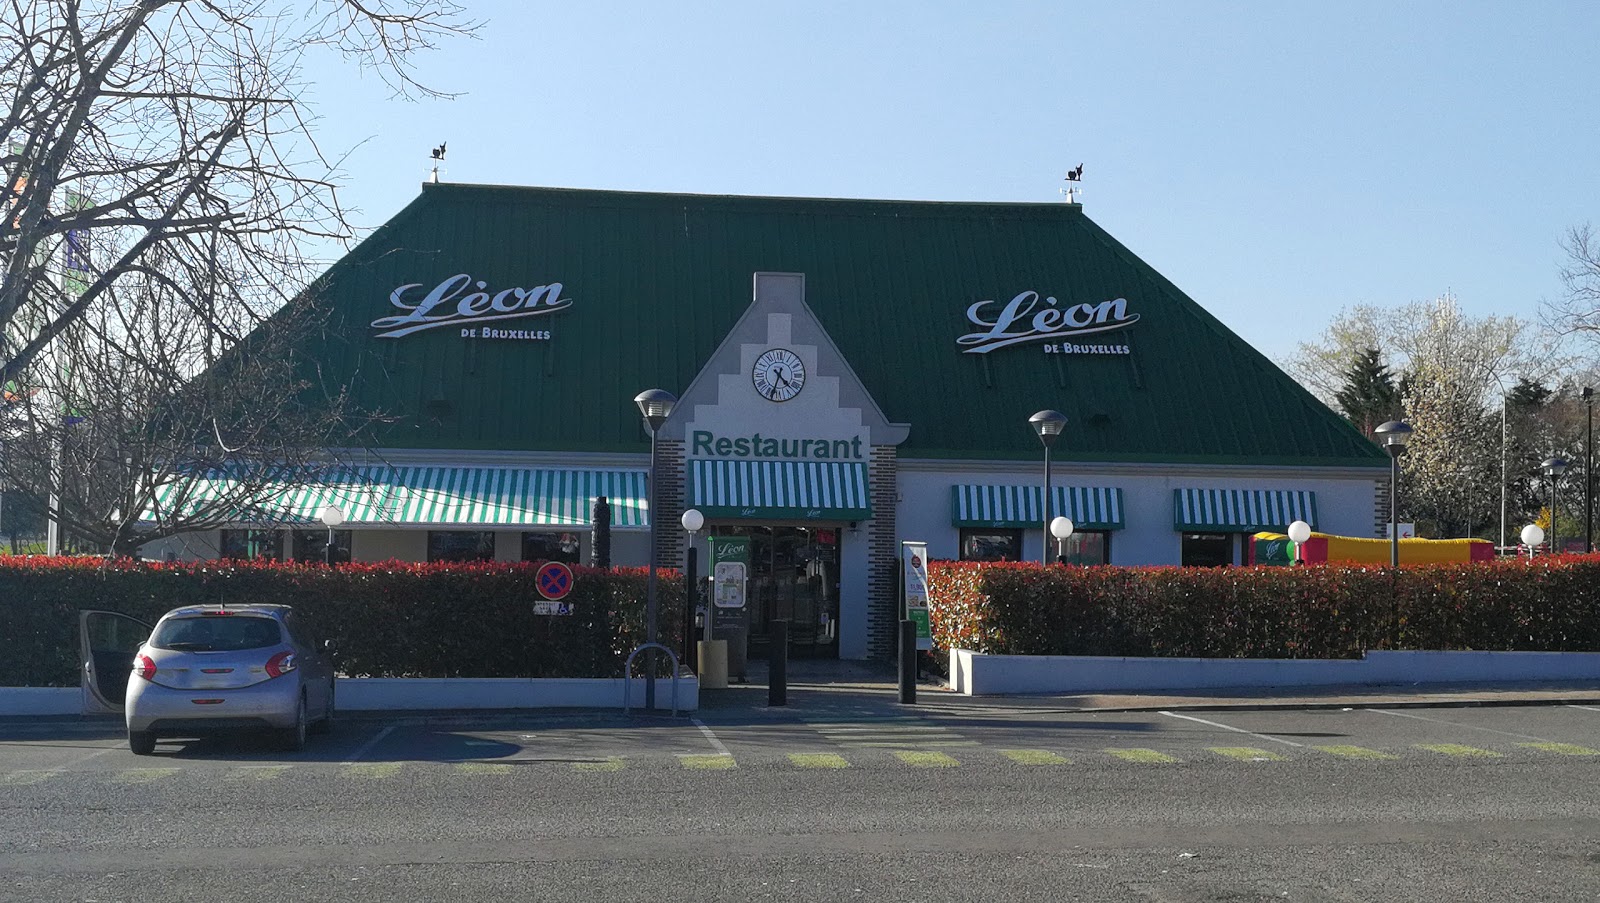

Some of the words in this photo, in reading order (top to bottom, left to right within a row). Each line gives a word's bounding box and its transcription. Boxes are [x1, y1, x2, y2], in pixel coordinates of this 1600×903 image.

[370, 273, 573, 338] Léon
[461, 328, 476, 338] DE
[482, 326, 551, 340] BRUXELLES
[956, 290, 1141, 353] Léon
[1043, 344, 1059, 354] DE
[1063, 342, 1131, 355] BRUXELLES
[692, 430, 863, 459] Restaurant
